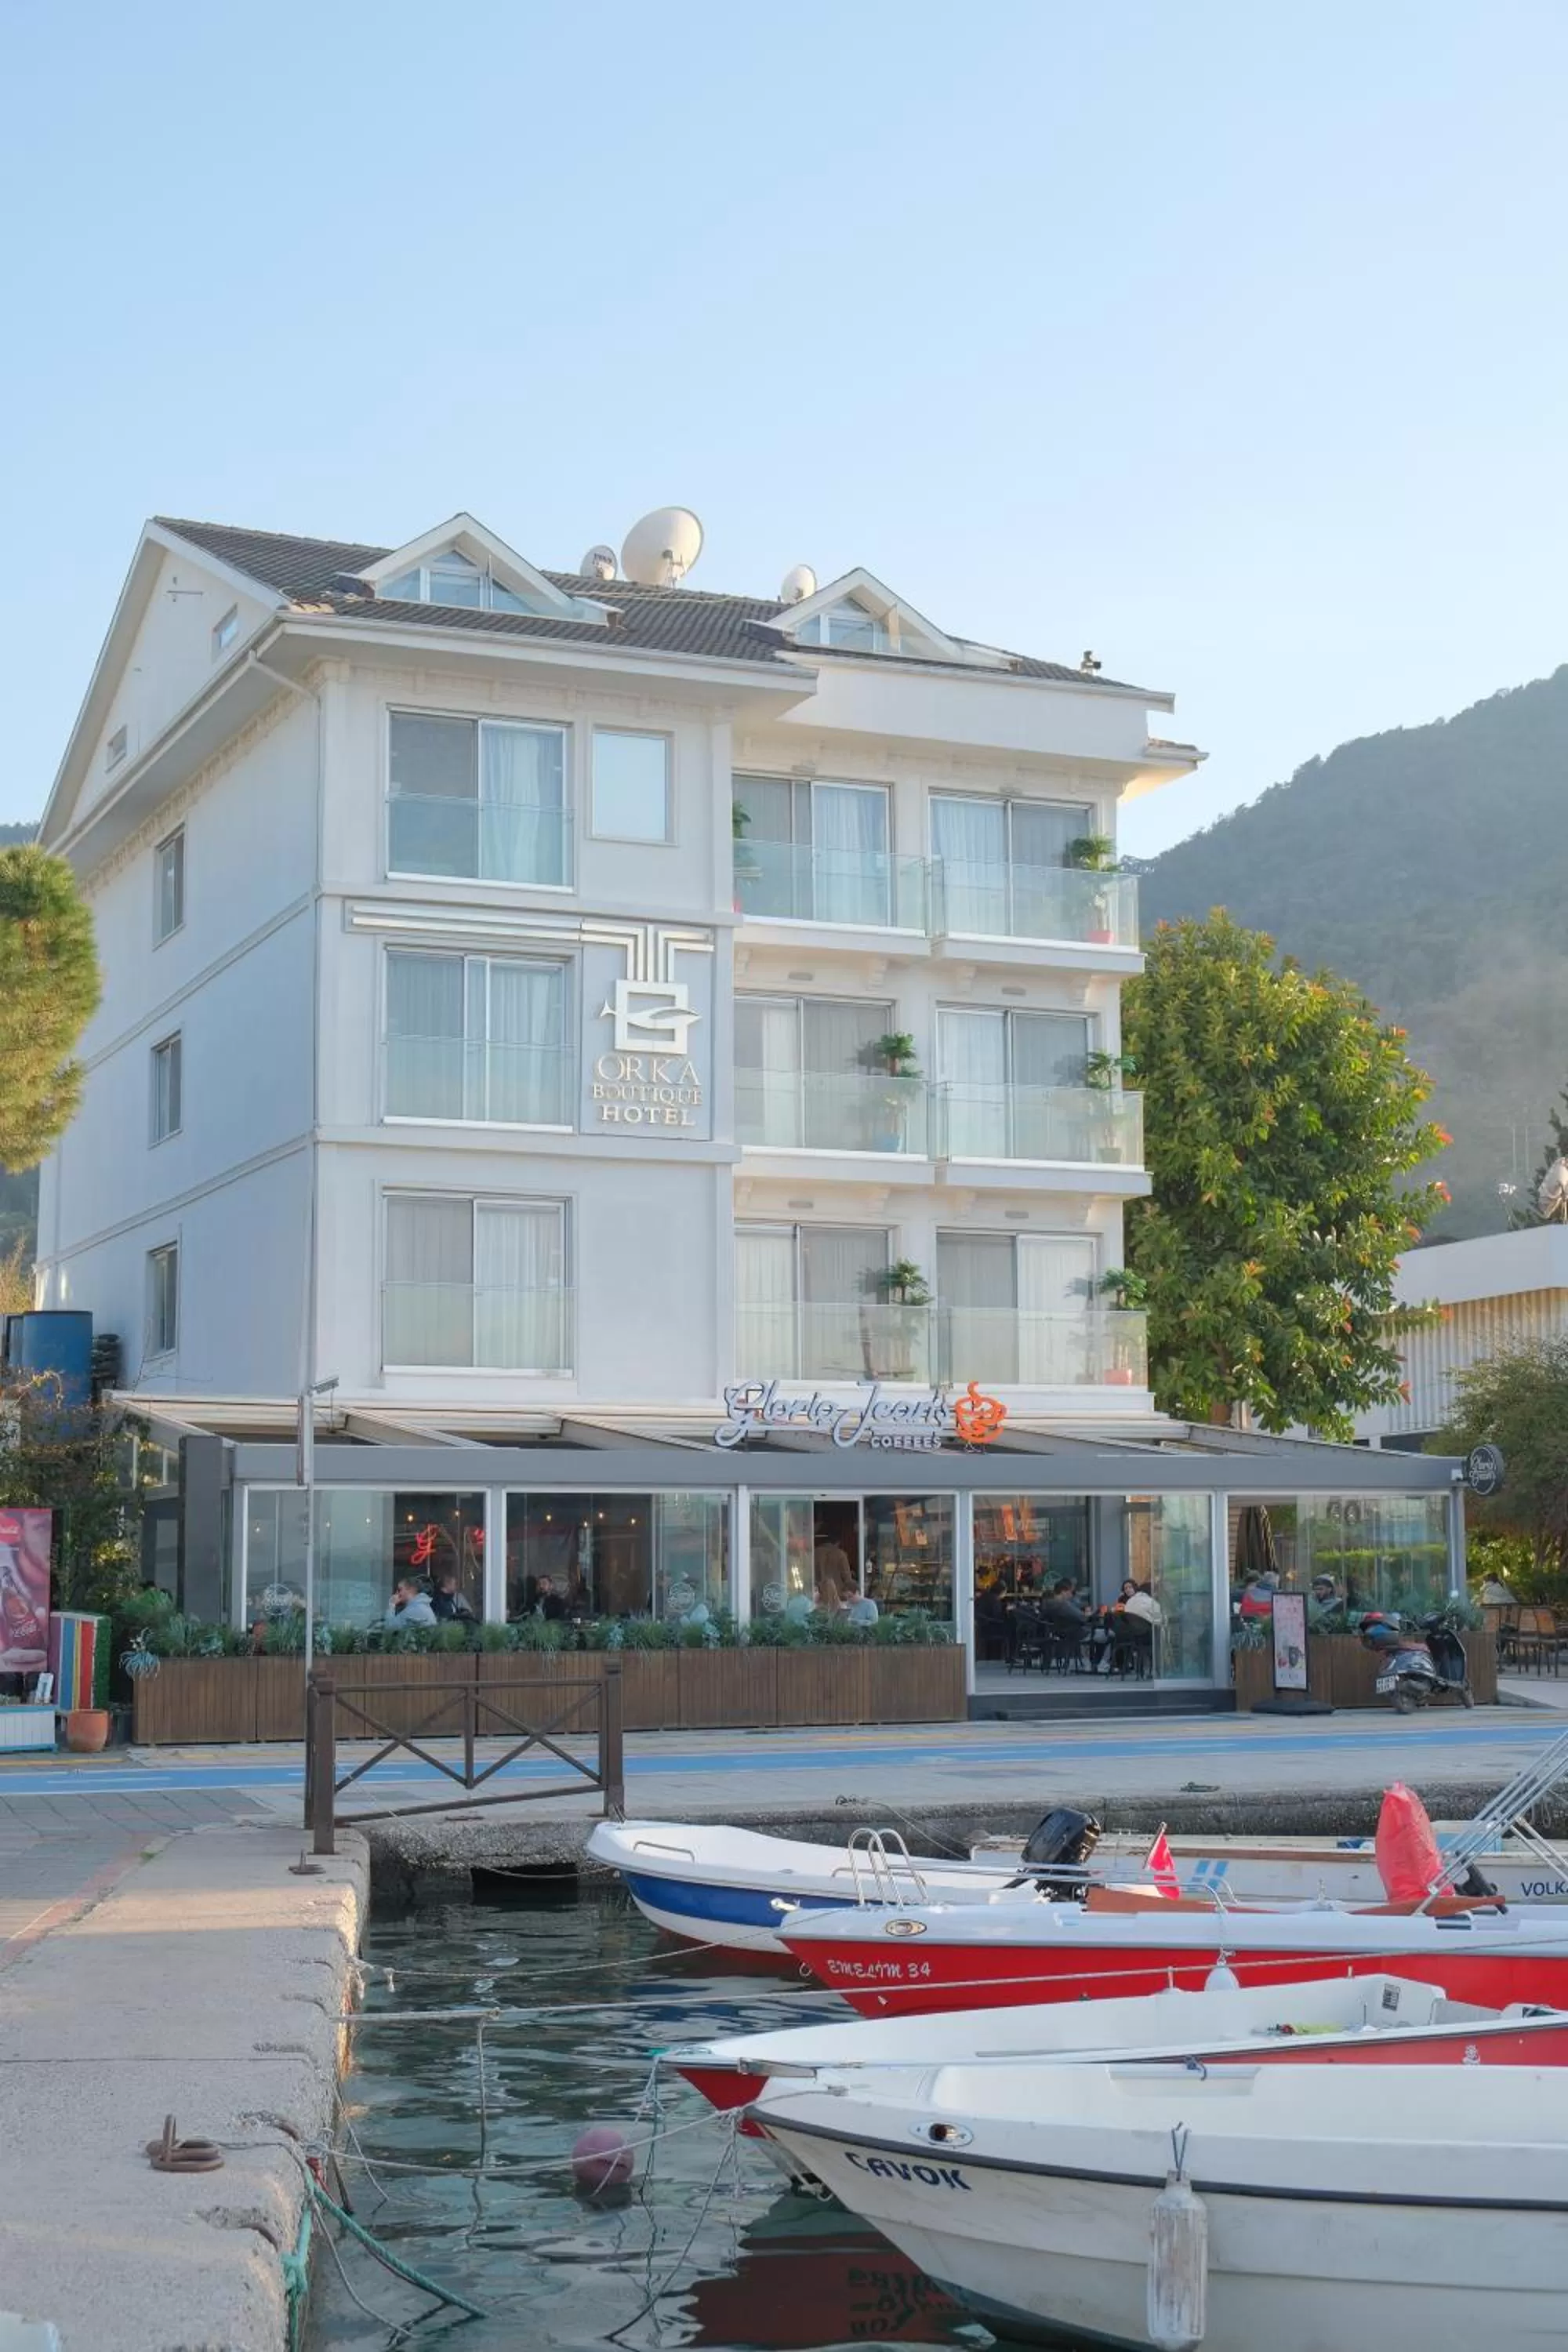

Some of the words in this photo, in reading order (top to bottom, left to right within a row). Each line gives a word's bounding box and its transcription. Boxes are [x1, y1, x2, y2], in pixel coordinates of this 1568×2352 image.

[597, 1054, 702, 1086] ORKA
[593, 1083, 702, 1106] BOUTIQUE
[601, 1104, 696, 1126] HOTEL
[715, 1380, 835, 1447] Gloria
[870, 1435, 942, 1450] COFFEES
[1521, 1881, 1568, 1897] VOLK
[907, 1961, 931, 1978] 34
[844, 2151, 972, 2191] CAVOK
